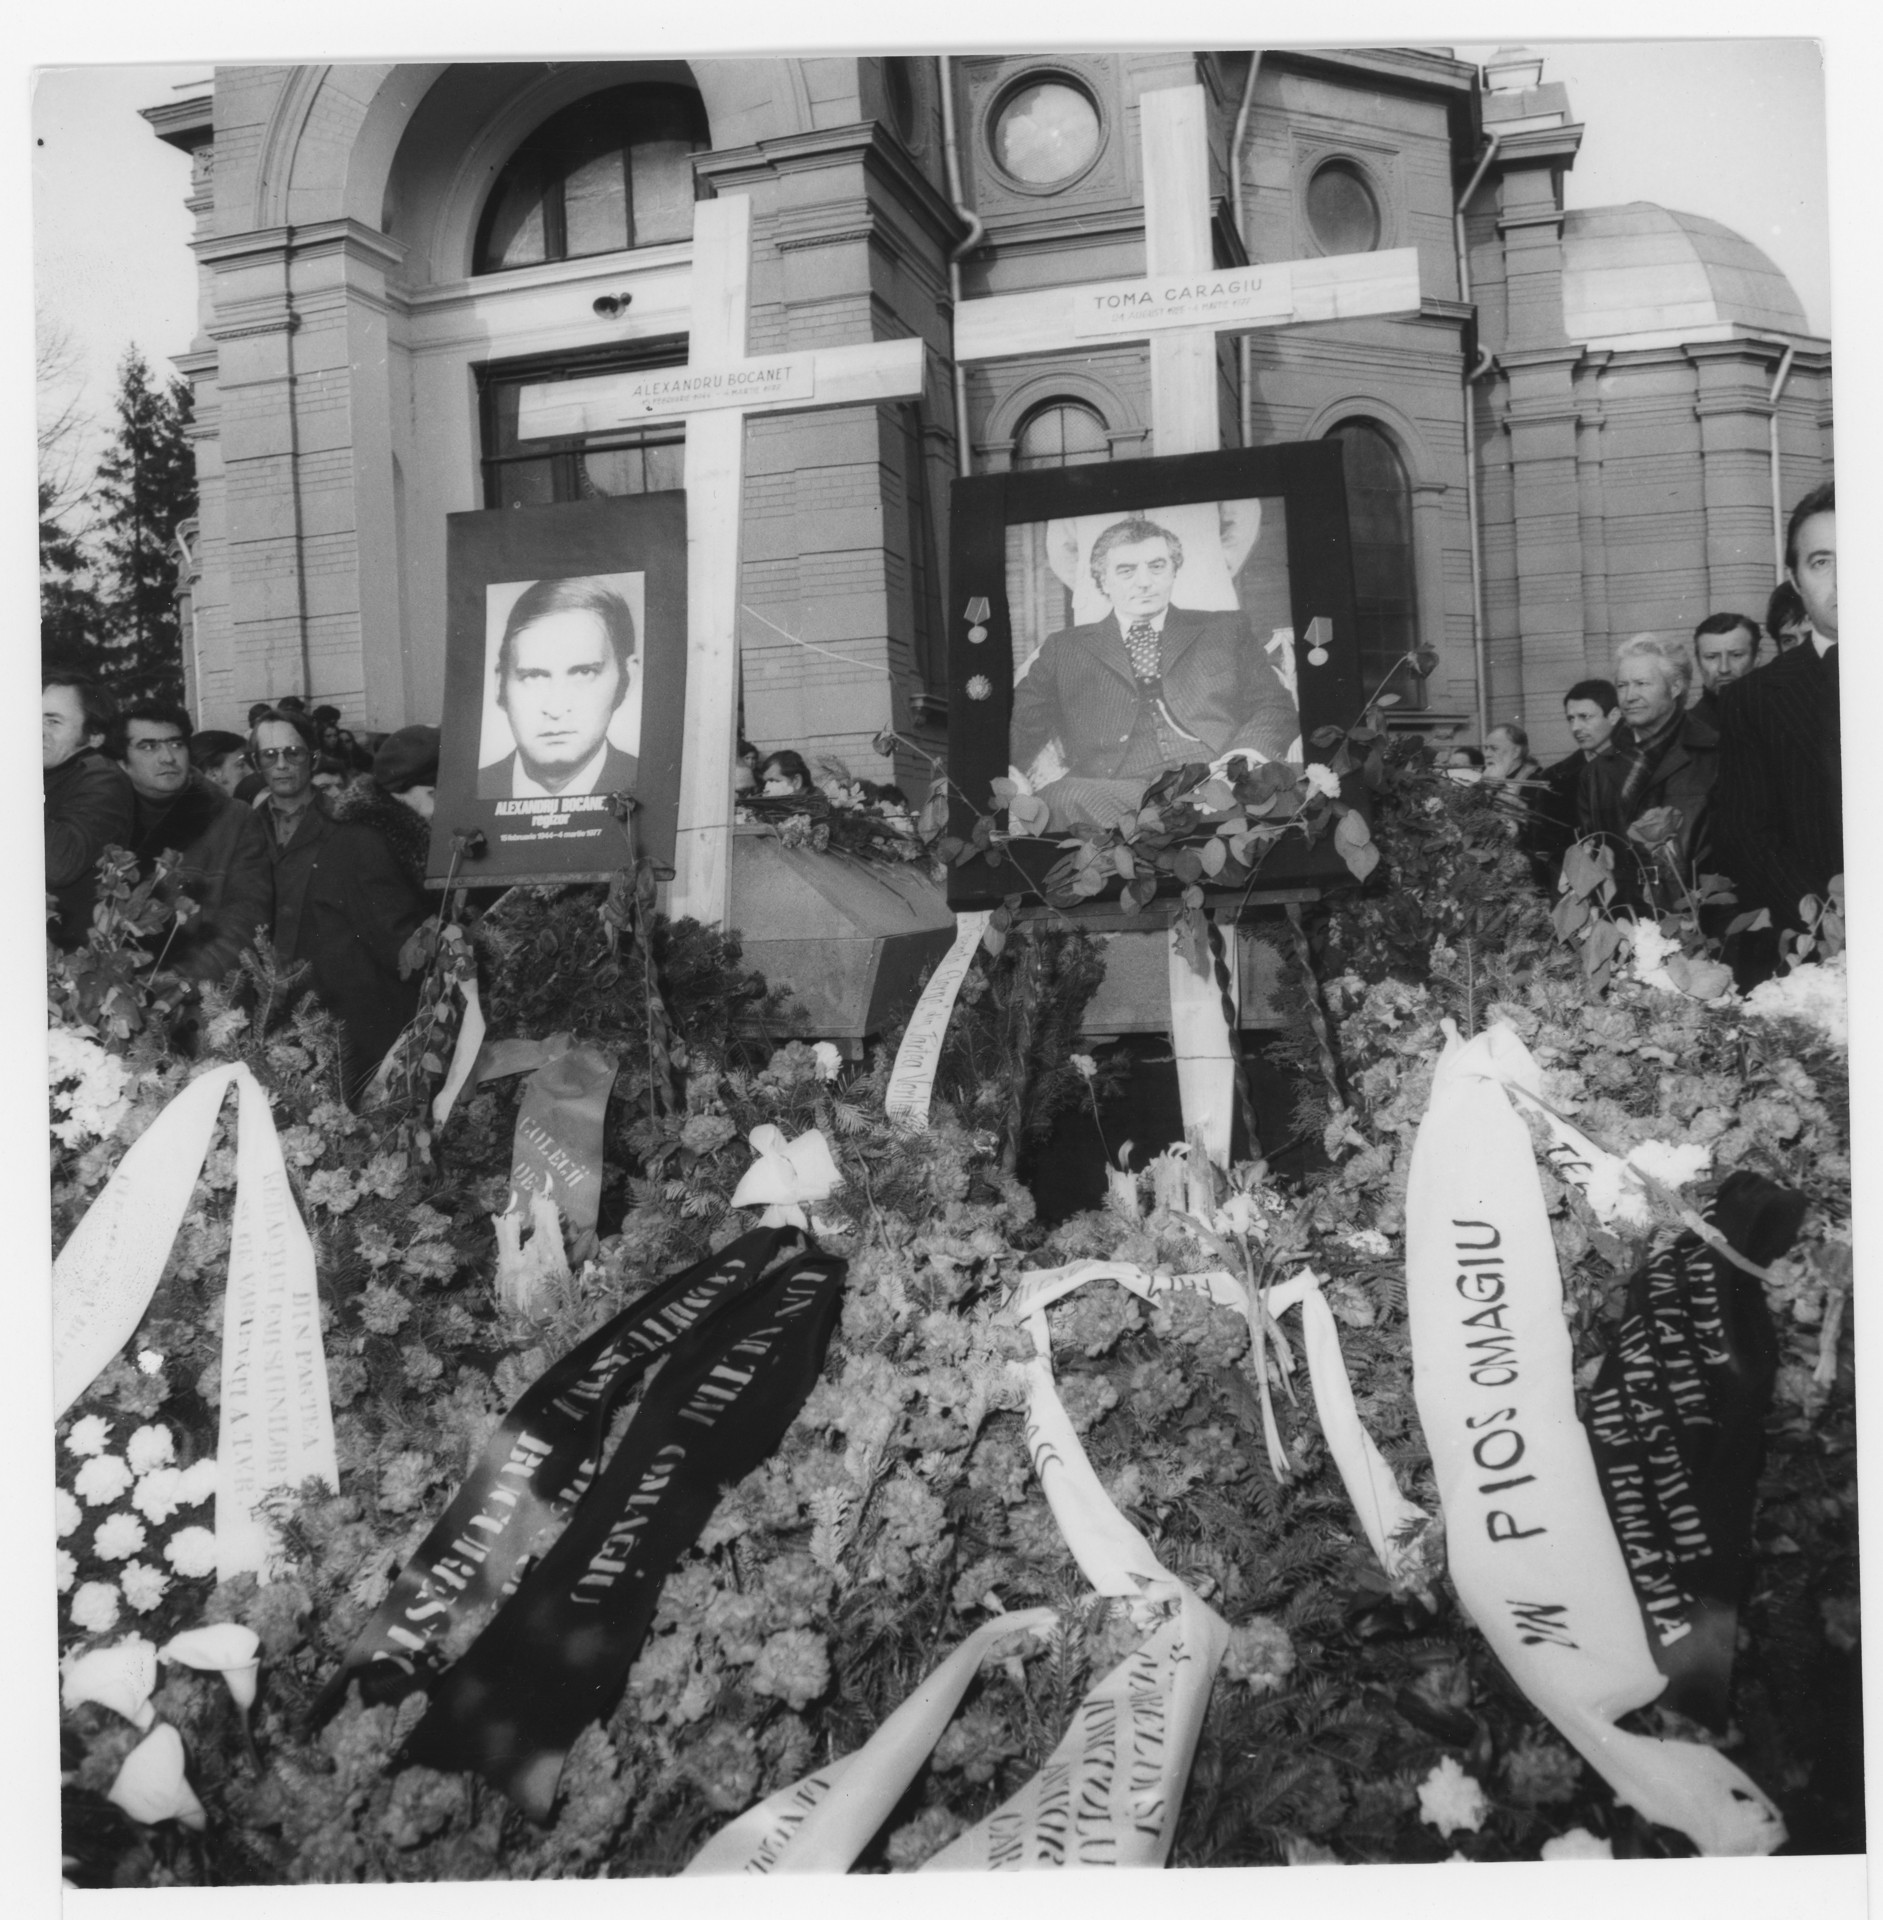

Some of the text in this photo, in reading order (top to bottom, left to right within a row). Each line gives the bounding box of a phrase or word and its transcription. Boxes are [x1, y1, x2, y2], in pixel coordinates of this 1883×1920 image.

[1094, 278, 1262, 309] TOMA CARAGIU
[632, 366, 793, 397] ALEXANDRU BOCANET
[494, 796, 609, 816] ALEXANDRU BOCANE
[531, 812, 571, 829] regizor
[774, 1271, 829, 1319] UN
[1451, 1218, 1519, 1387] OMAGIU
[292, 1290, 320, 1451] DIN PARTEA
[677, 1326, 786, 1427] ULTIM
[1591, 1387, 1641, 1448] DIN
[1464, 1407, 1548, 1543] PIOS
[570, 1444, 687, 1604] OMAGIU
